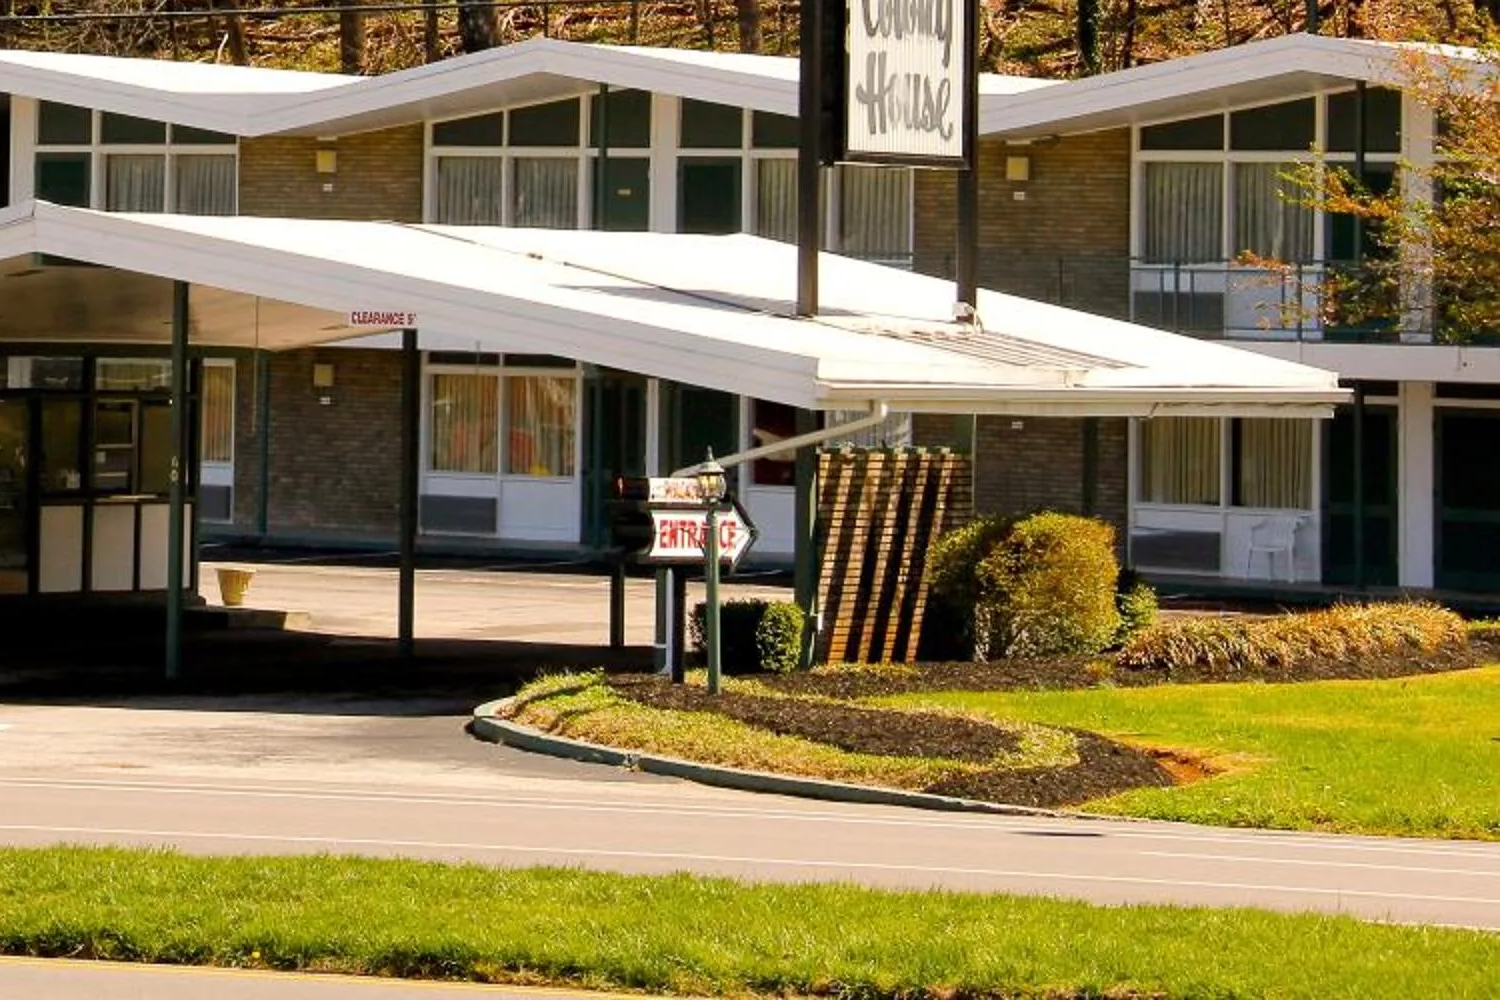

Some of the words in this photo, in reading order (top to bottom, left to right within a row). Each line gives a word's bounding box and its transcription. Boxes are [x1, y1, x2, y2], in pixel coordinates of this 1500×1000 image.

[856, 51, 953, 141] House
[351, 311, 404, 325] CLEARANCE
[659, 519, 737, 549] ENTRACE
